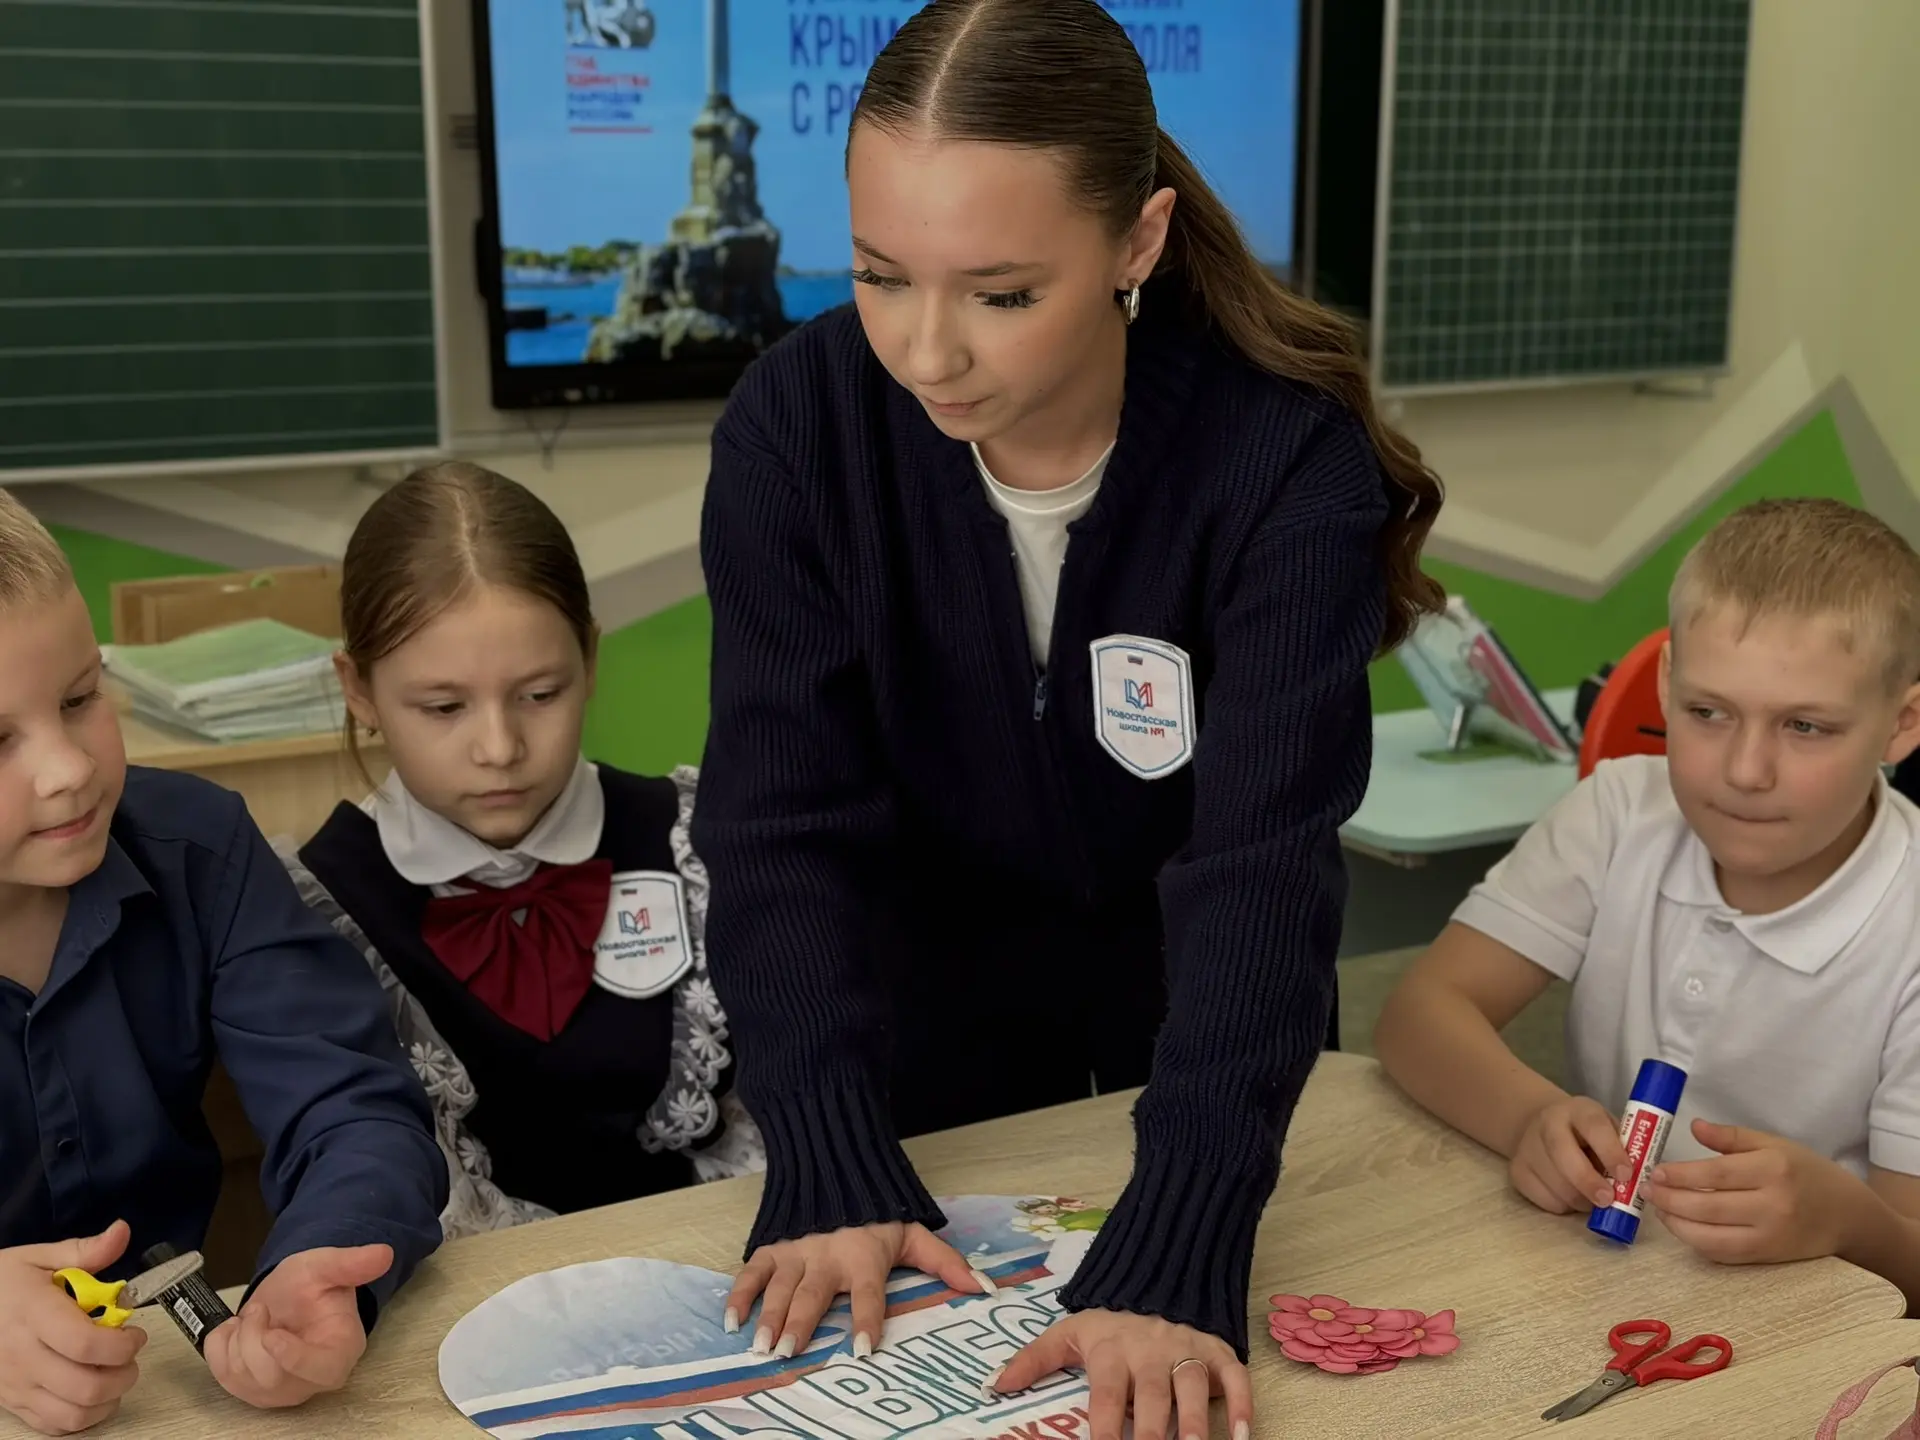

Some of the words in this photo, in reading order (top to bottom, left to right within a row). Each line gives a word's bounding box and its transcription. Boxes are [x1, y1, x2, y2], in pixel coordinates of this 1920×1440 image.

[792, 81, 811, 134] С
[1106, 707, 1177, 728] Новоспасская
[1119, 722, 1148, 735] школа
